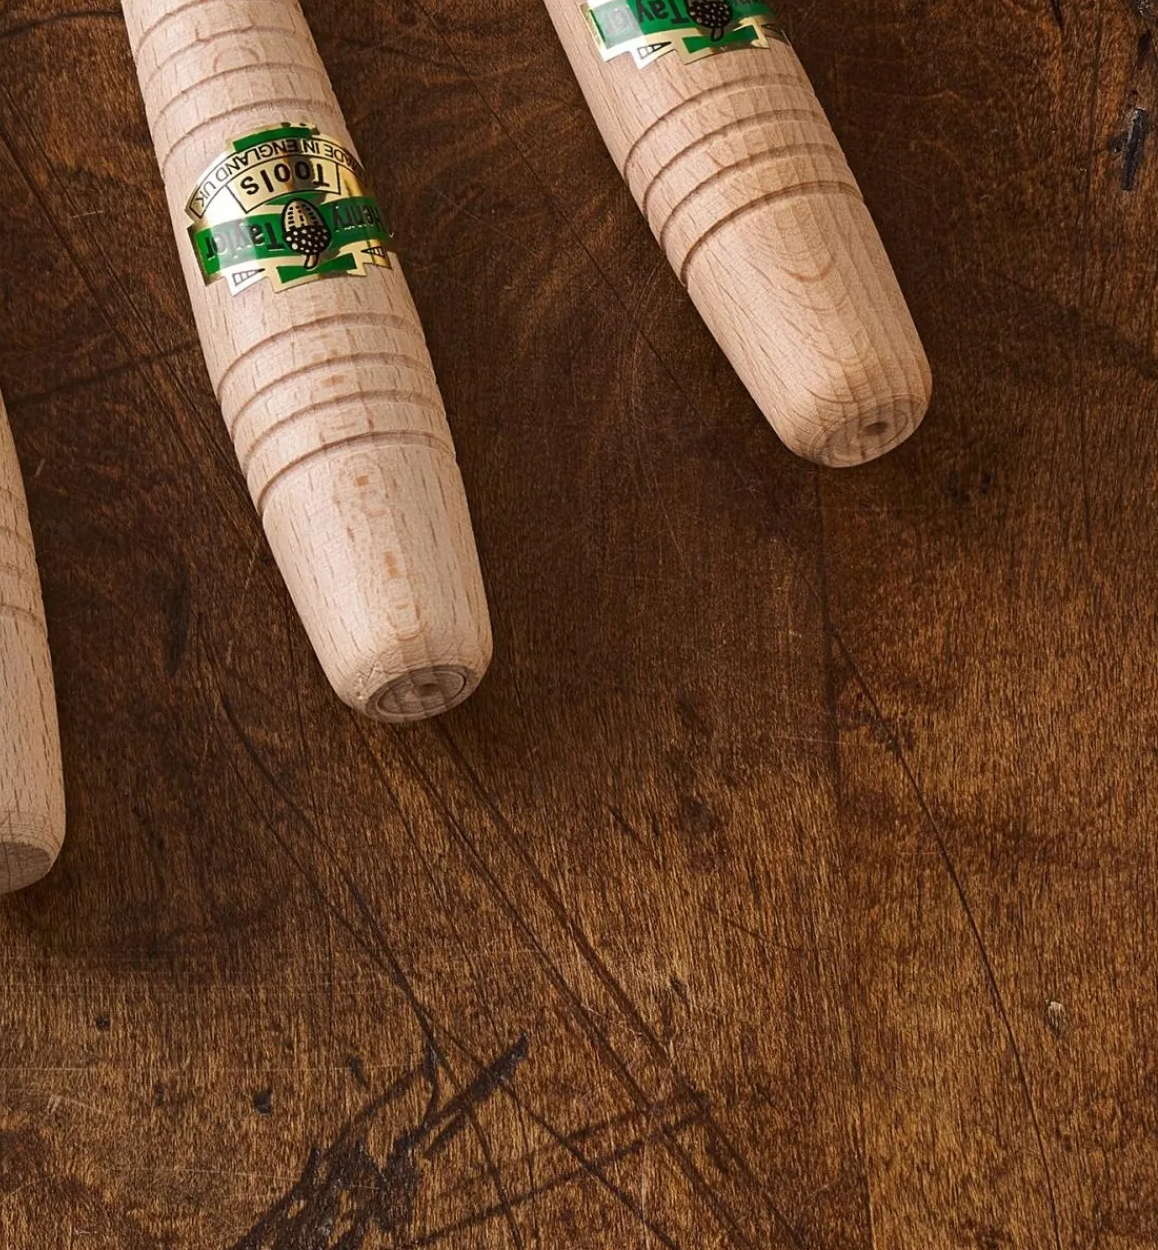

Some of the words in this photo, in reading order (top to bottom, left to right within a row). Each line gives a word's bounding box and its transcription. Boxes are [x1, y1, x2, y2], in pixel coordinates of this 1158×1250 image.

[215, 140, 298, 182] ENGLAND
[302, 140, 321, 155] IN
[197, 182, 217, 209] UK
[240, 162, 330, 196] Tools
[205, 220, 283, 261] Taylor
